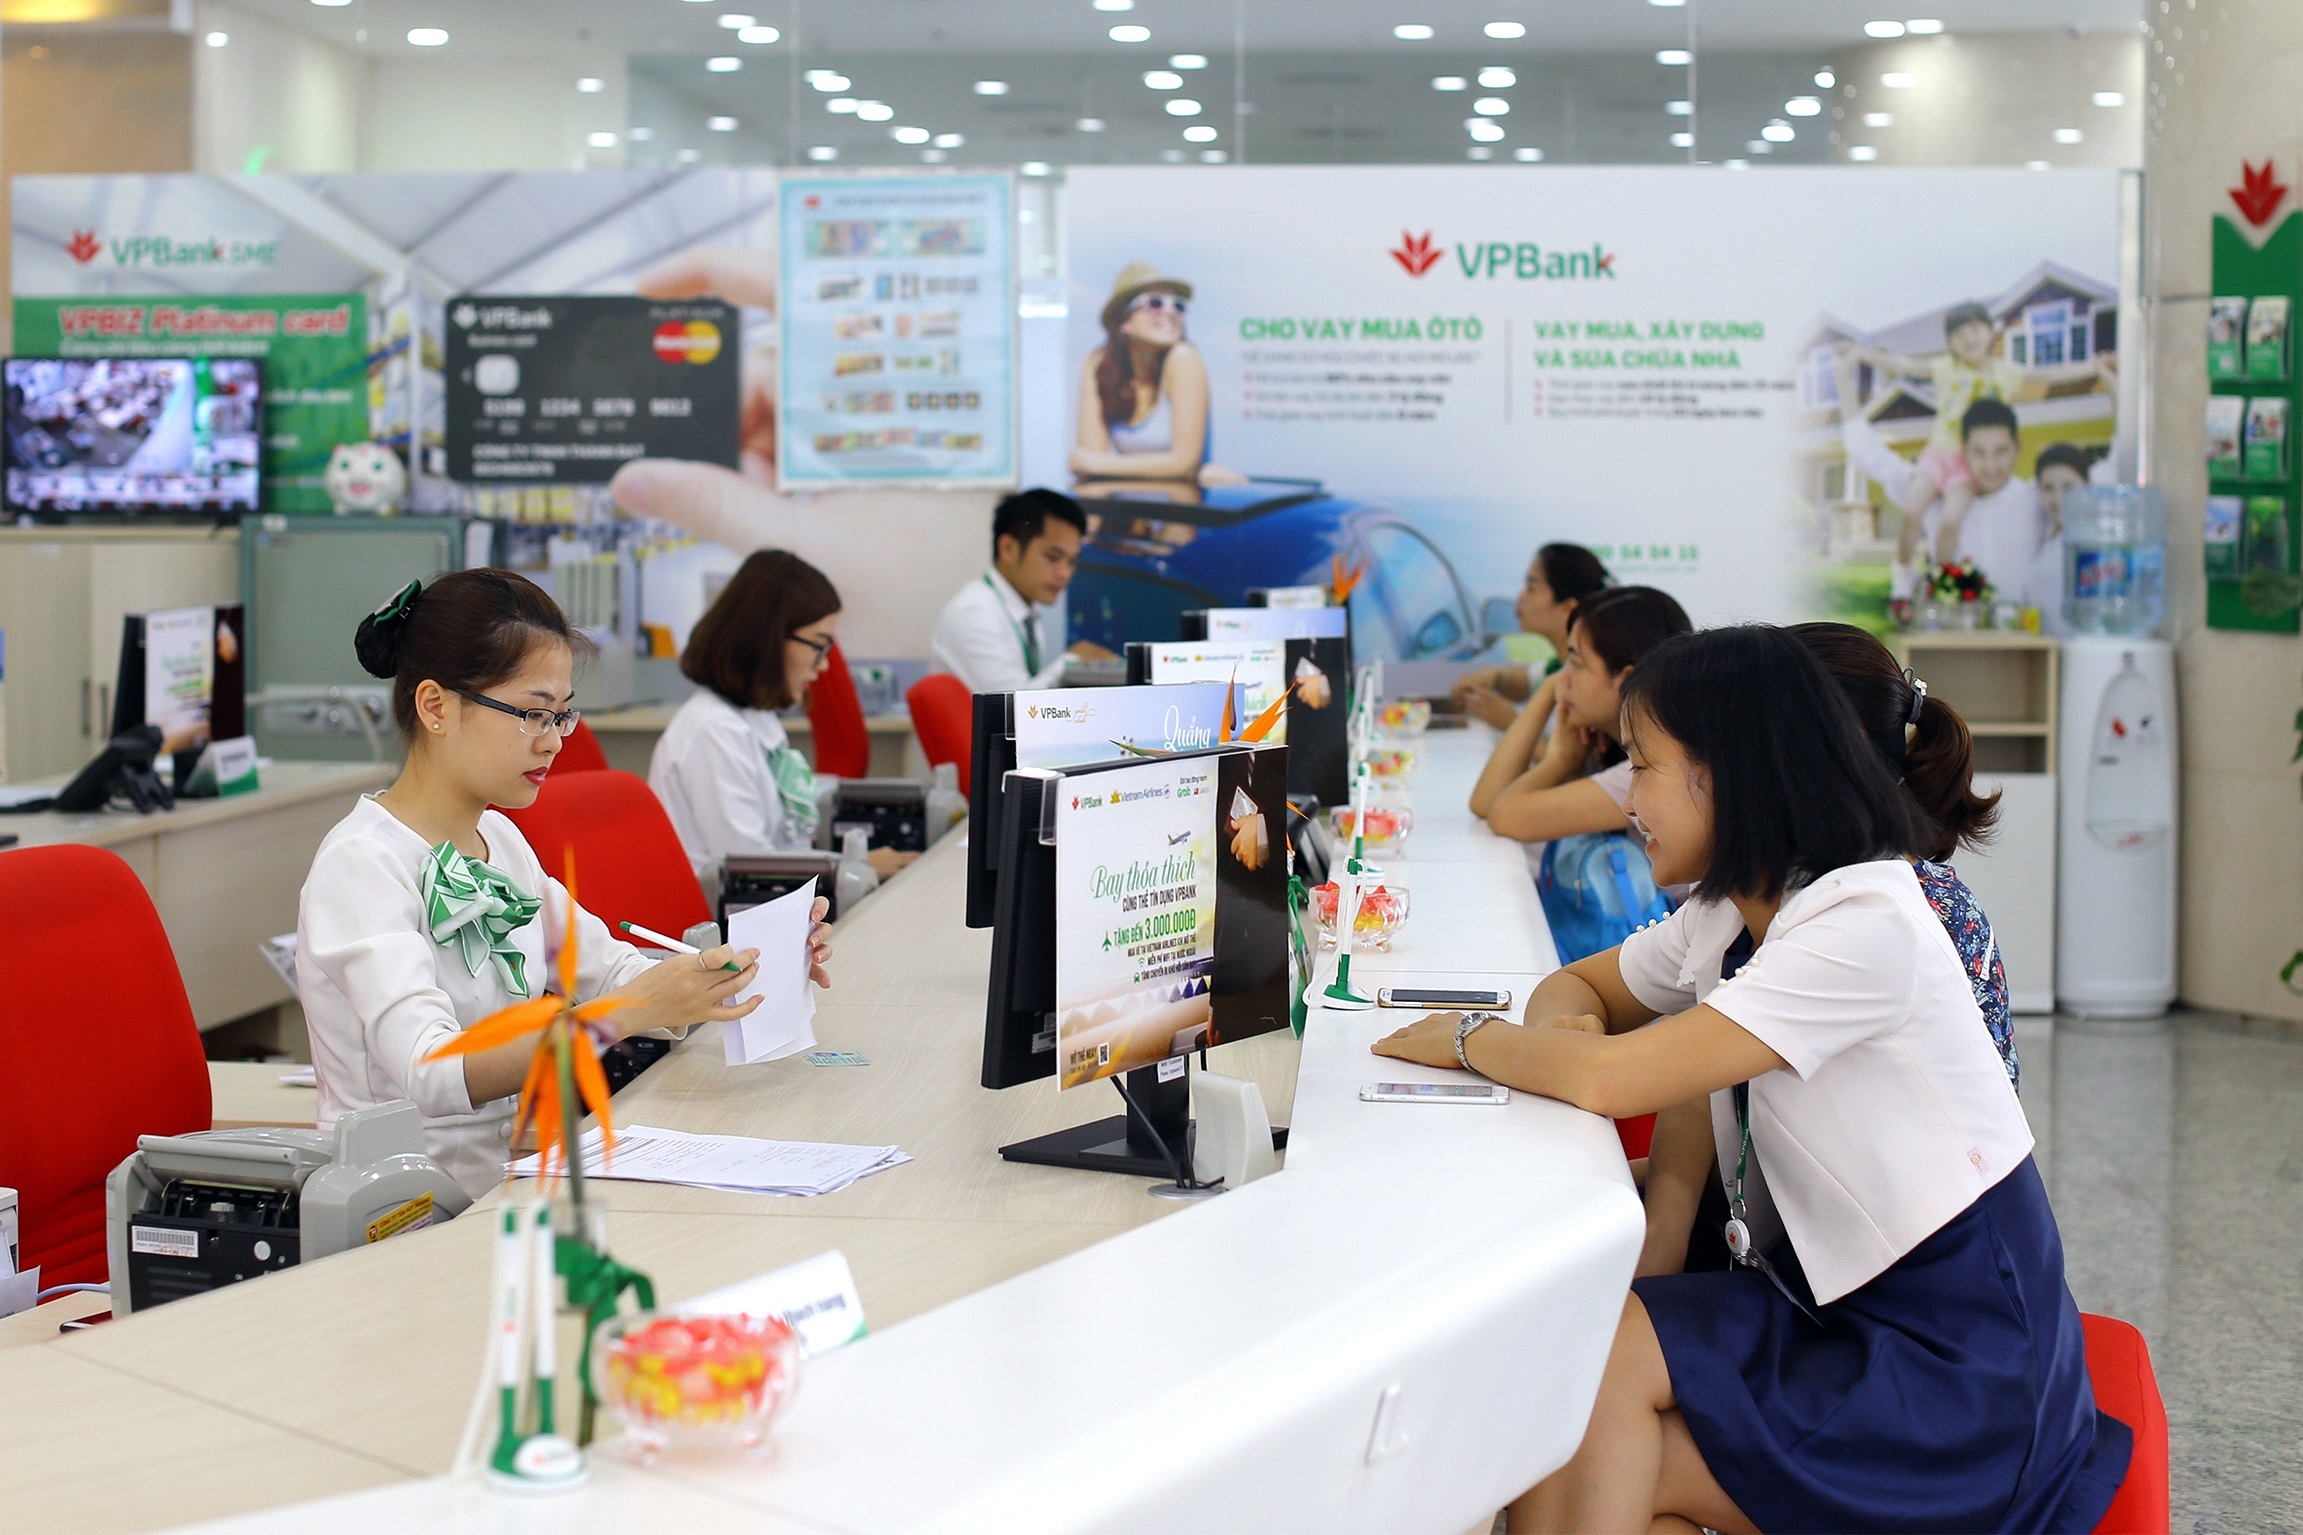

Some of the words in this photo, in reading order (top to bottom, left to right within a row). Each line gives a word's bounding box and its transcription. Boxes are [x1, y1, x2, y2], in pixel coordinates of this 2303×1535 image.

[111, 237, 224, 265] VPBank
[1456, 242, 1617, 280] VPBank
[152, 304, 277, 337] Platinum
[282, 304, 350, 337] card
[479, 307, 552, 328] VPBank
[1239, 316, 1297, 341] CHO
[1301, 316, 1355, 341] VAY
[1360, 316, 1422, 341] MUA
[1427, 313, 1484, 341] ÔTÔ
[1533, 320, 1581, 341] VAY
[1584, 320, 1645, 342] MUA,
[1649, 317, 1694, 341] XÂY
[1533, 346, 1566, 369] VÀ
[1691, 347, 1742, 369] NHÀ
[1040, 707, 1071, 719] VPBank
[1163, 704, 1211, 751] Quảng
[1081, 795, 1103, 810] VPBank
[1120, 791, 1143, 803] Vietnam
[1143, 787, 1163, 798] Airlines
[1177, 785, 1191, 798] Grab
[1090, 865, 1125, 904] Bay
[1161, 850, 1197, 886] thích
[1122, 894, 1138, 913] CÙNG
[1150, 888, 1159, 907] TÍN
[1160, 888, 1174, 907] DỤNG
[1174, 884, 1197, 902] VPBANK
[1114, 927, 1130, 949] TẶNG
[1131, 921, 1144, 943] ĐẾN
[1145, 908, 1197, 940] 3.000.000Đ
